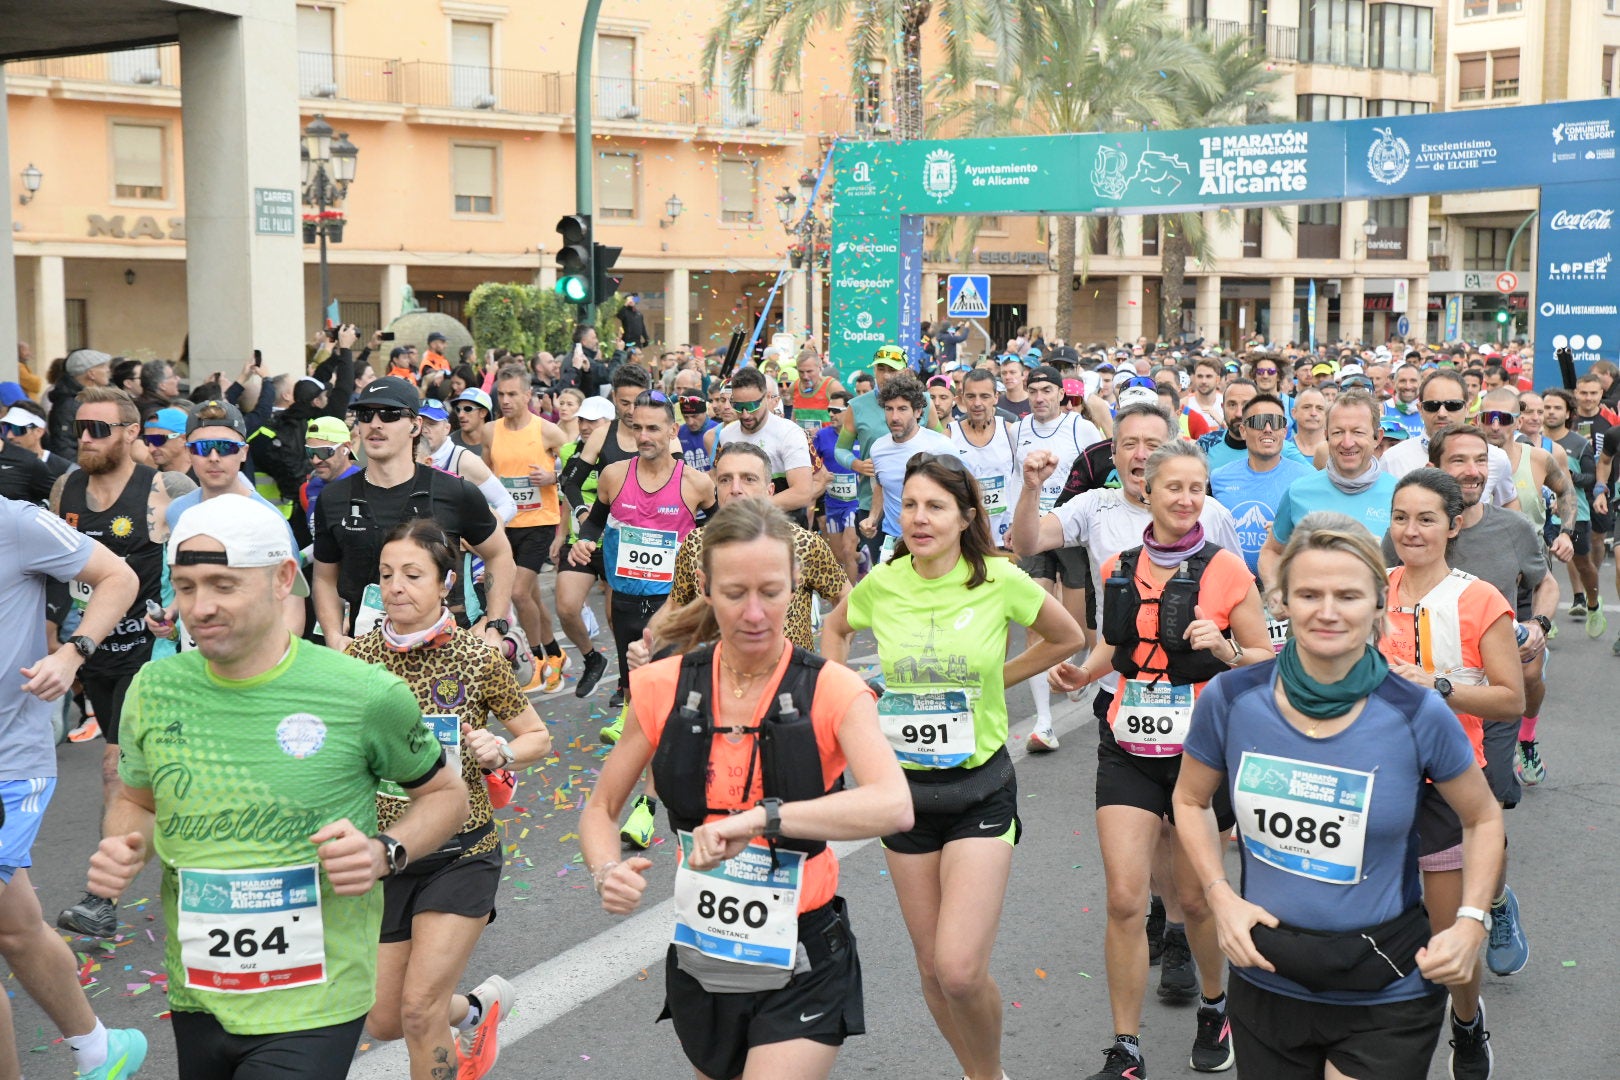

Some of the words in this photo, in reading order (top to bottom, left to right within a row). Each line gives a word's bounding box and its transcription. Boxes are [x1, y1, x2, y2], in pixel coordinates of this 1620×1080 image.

[1565, 125, 1609, 134] COMUNITAT
[1568, 133, 1578, 141] DE
[1580, 130, 1615, 140] L'ESPORT
[1223, 129, 1307, 149] MARATÓN
[1223, 145, 1307, 157] INTERNACIONAL
[1421, 140, 1491, 152] Excelentísimo
[1415, 149, 1497, 162] AYUNTAMIENTO
[965, 163, 1038, 176] Ayuntamiento
[1199, 157, 1267, 178] Elche
[1270, 159, 1307, 174] 42K
[1433, 163, 1445, 171] de
[1447, 160, 1479, 170] ELCHE
[973, 176, 985, 186] de
[987, 175, 1030, 186] Alicante
[1198, 170, 1307, 195] Alicante
[263, 190, 292, 202] CARRER
[1556, 304, 1570, 315] HLA
[1571, 306, 1617, 315] VISTAHERMOSA
[844, 330, 885, 343] Coplaca
[1553, 351, 1601, 361] Suritas
[509, 491, 534, 501] 657
[629, 550, 663, 566] 900
[1127, 715, 1173, 734] 980
[902, 724, 948, 744] 991
[1288, 785, 1335, 802] Alicante
[1254, 808, 1341, 848] 1086
[1280, 844, 1311, 855] LAETITIA
[724, 866, 768, 881] Alicante
[241, 878, 283, 888] MARATÓN
[231, 890, 264, 901] Elche
[231, 898, 284, 909] Alicante
[698, 890, 768, 928] 860
[707, 926, 749, 939] CONSTANCE
[208, 926, 289, 957] 264
